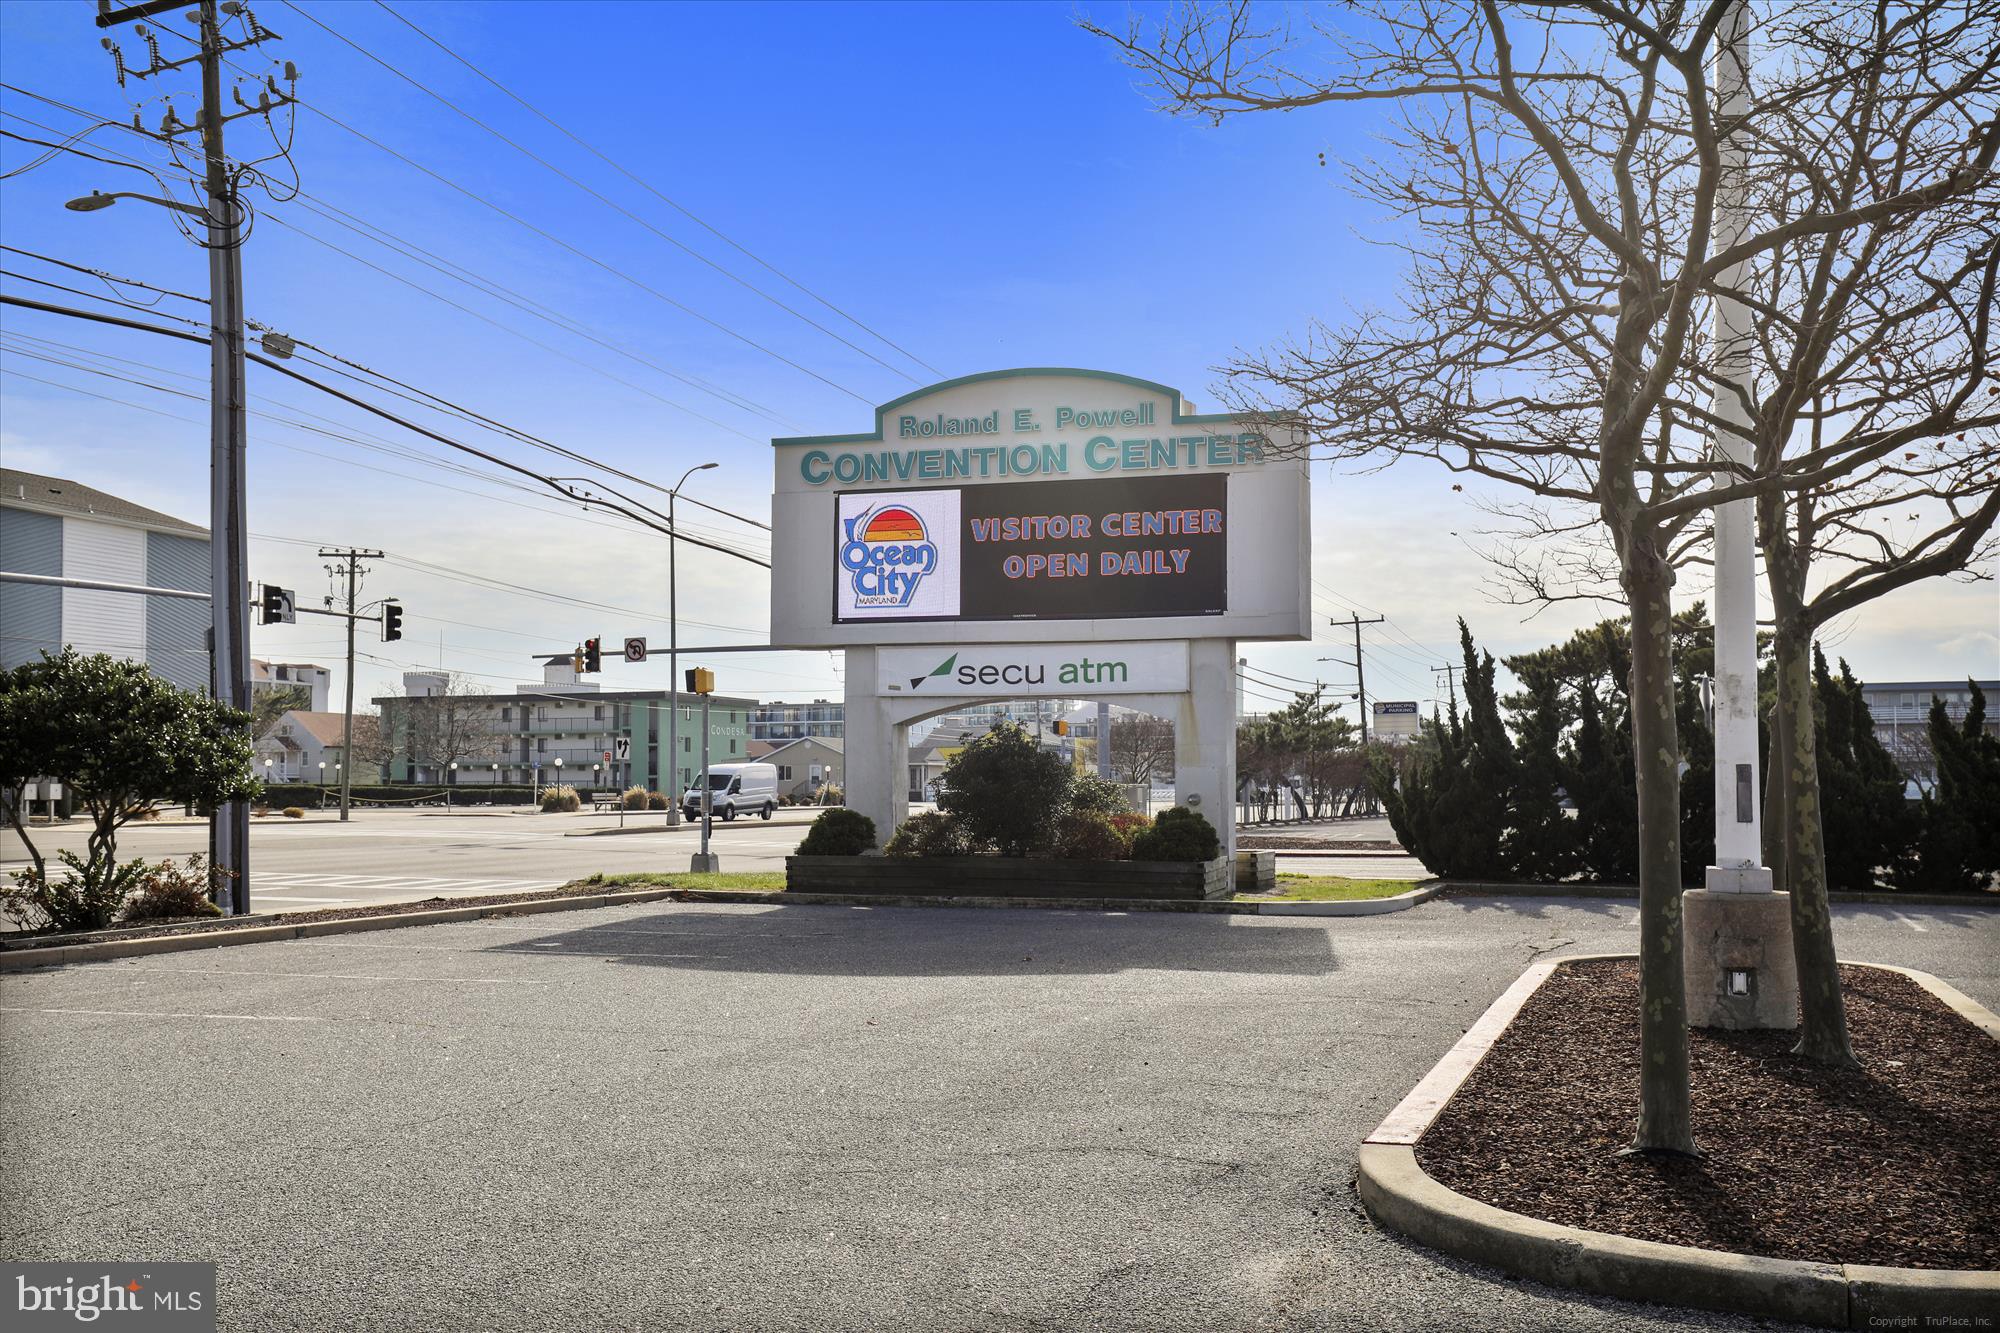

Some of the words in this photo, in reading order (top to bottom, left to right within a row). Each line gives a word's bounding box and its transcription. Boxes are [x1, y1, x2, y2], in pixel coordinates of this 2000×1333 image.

[899, 411, 999, 438] Roland
[1014, 409, 1041, 432] E.
[1056, 402, 1155, 429] Powell
[801, 443, 1069, 485] CONVENTION
[1084, 433, 1265, 471] CENTER
[971, 515, 1092, 541] VISITOR
[1101, 509, 1222, 537] CENTER
[844, 542, 934, 571] Ocean
[1003, 552, 1088, 578] OPEN
[1100, 549, 1190, 576] DAILY
[855, 566, 920, 603] City
[859, 597, 897, 605] MARYLAND
[958, 664, 1044, 685] secu
[1058, 658, 1127, 684] atm
